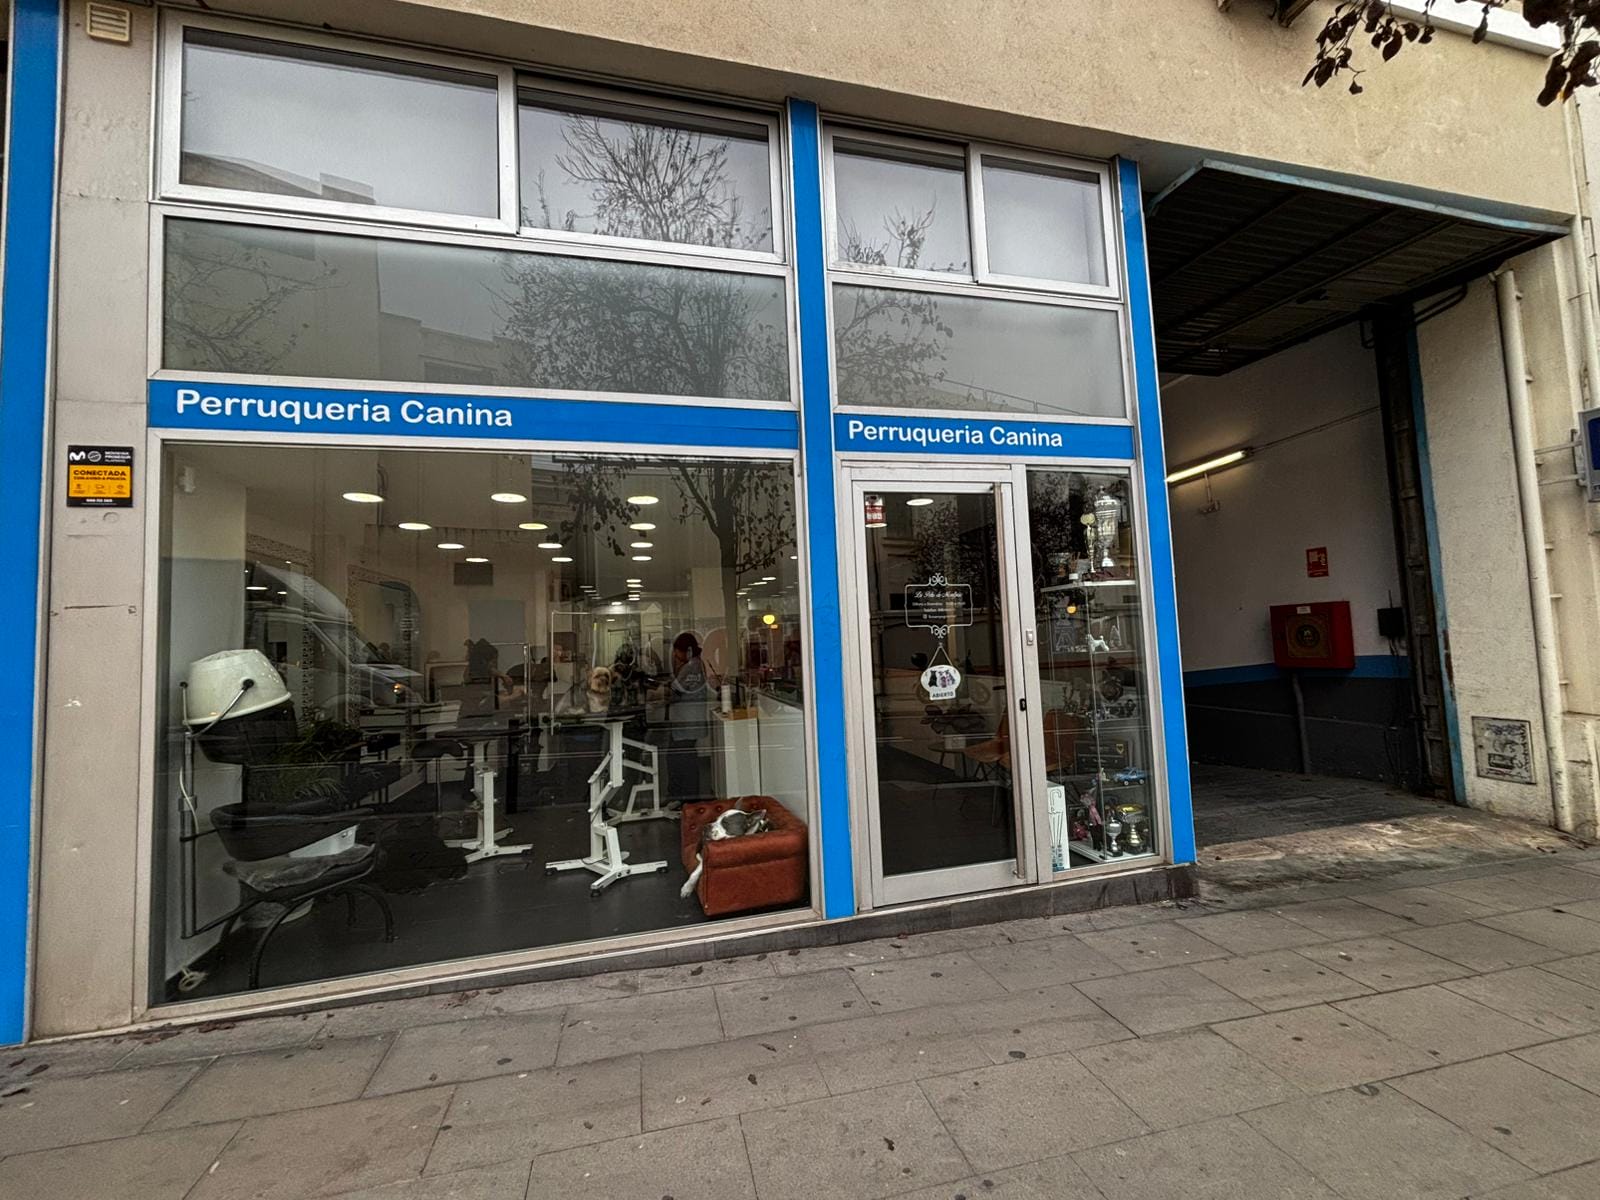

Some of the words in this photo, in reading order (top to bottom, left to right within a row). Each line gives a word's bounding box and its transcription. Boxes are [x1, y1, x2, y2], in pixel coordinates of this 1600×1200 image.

[176, 388, 391, 425] Perruqueria
[400, 399, 513, 427] Canina
[848, 420, 984, 447] Perruqueria
[989, 426, 1063, 447] Canina
